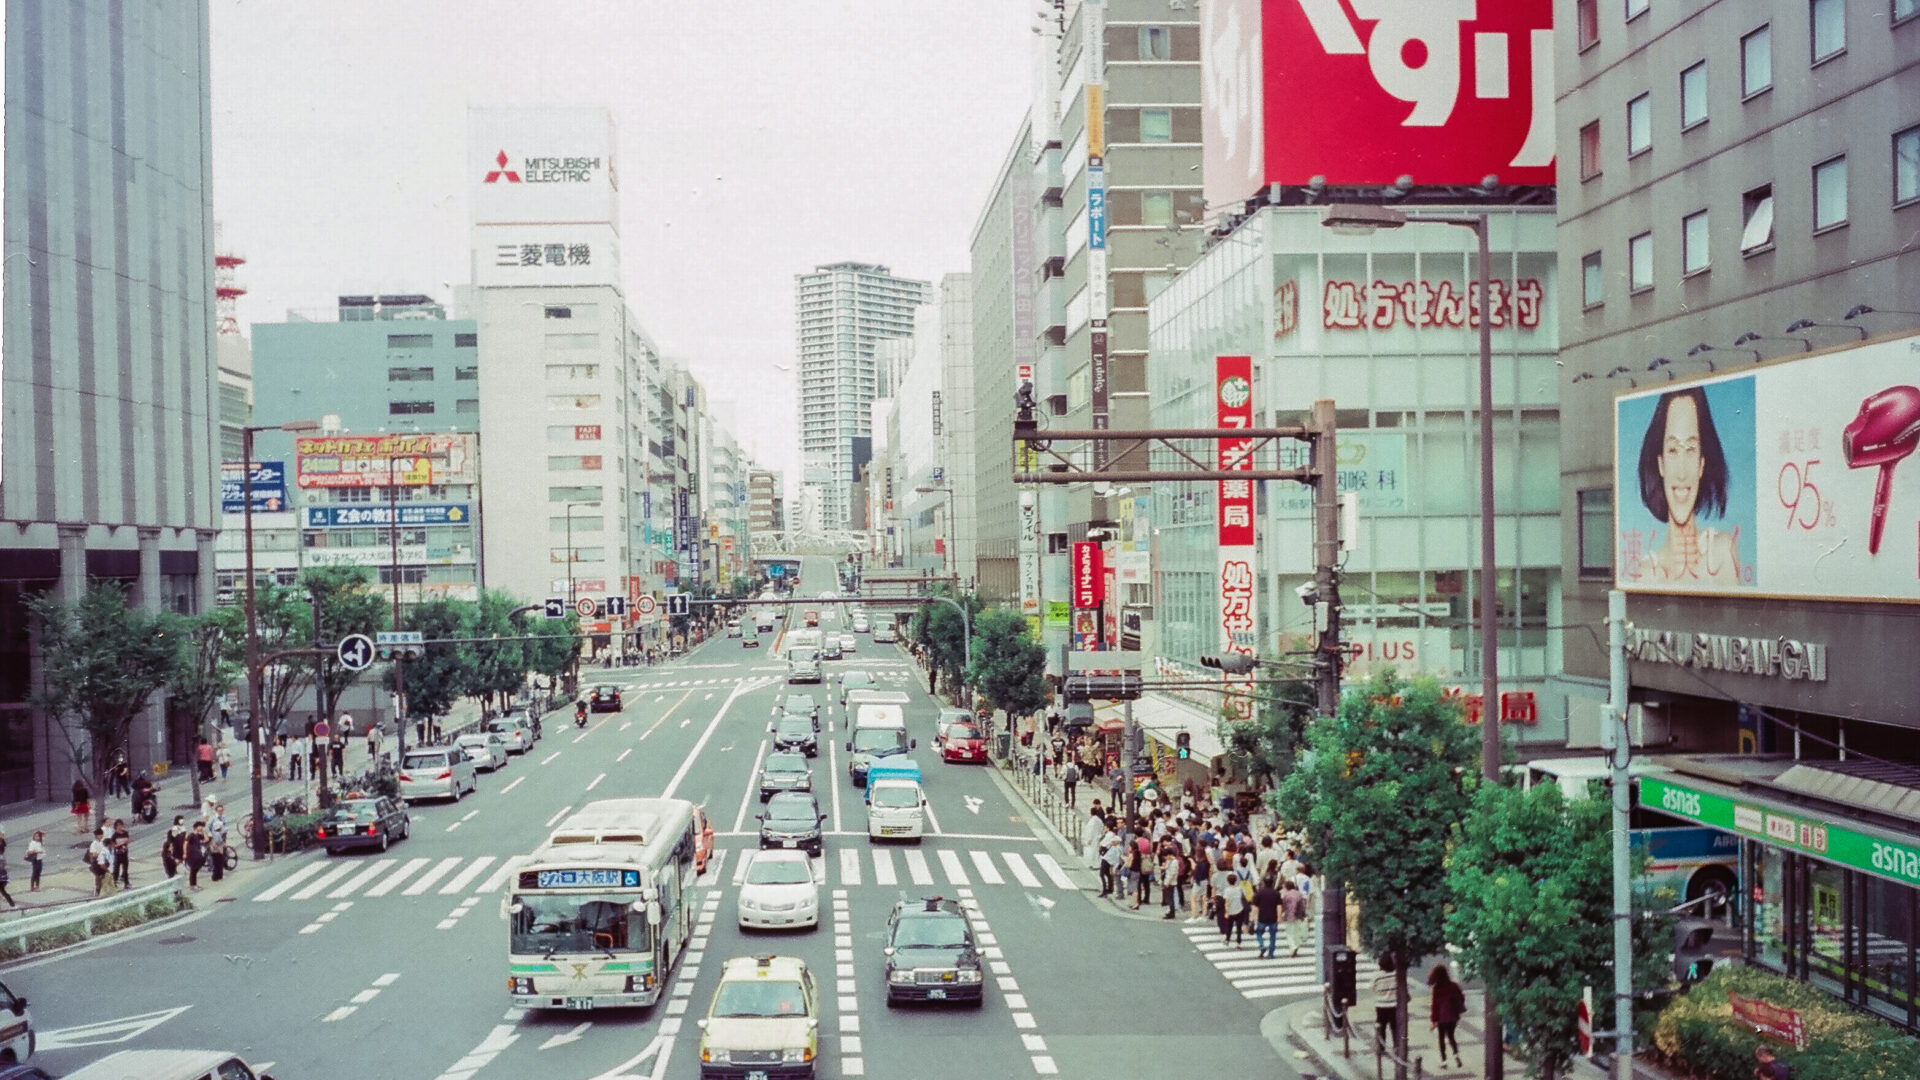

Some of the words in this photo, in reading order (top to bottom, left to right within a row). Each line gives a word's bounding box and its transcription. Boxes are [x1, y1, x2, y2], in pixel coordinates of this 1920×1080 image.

[525, 157, 600, 170] MITSUBISHI
[525, 170, 591, 182] ELECTRIC
[496, 243, 591, 267] 三菱電機
[1323, 280, 1543, 330] 処方せん受付
[1692, 632, 1828, 682] SANBAN-GAI
[1662, 787, 1700, 816] asnas
[1872, 842, 1920, 883] asna
[578, 870, 618, 885] 大阪駅
